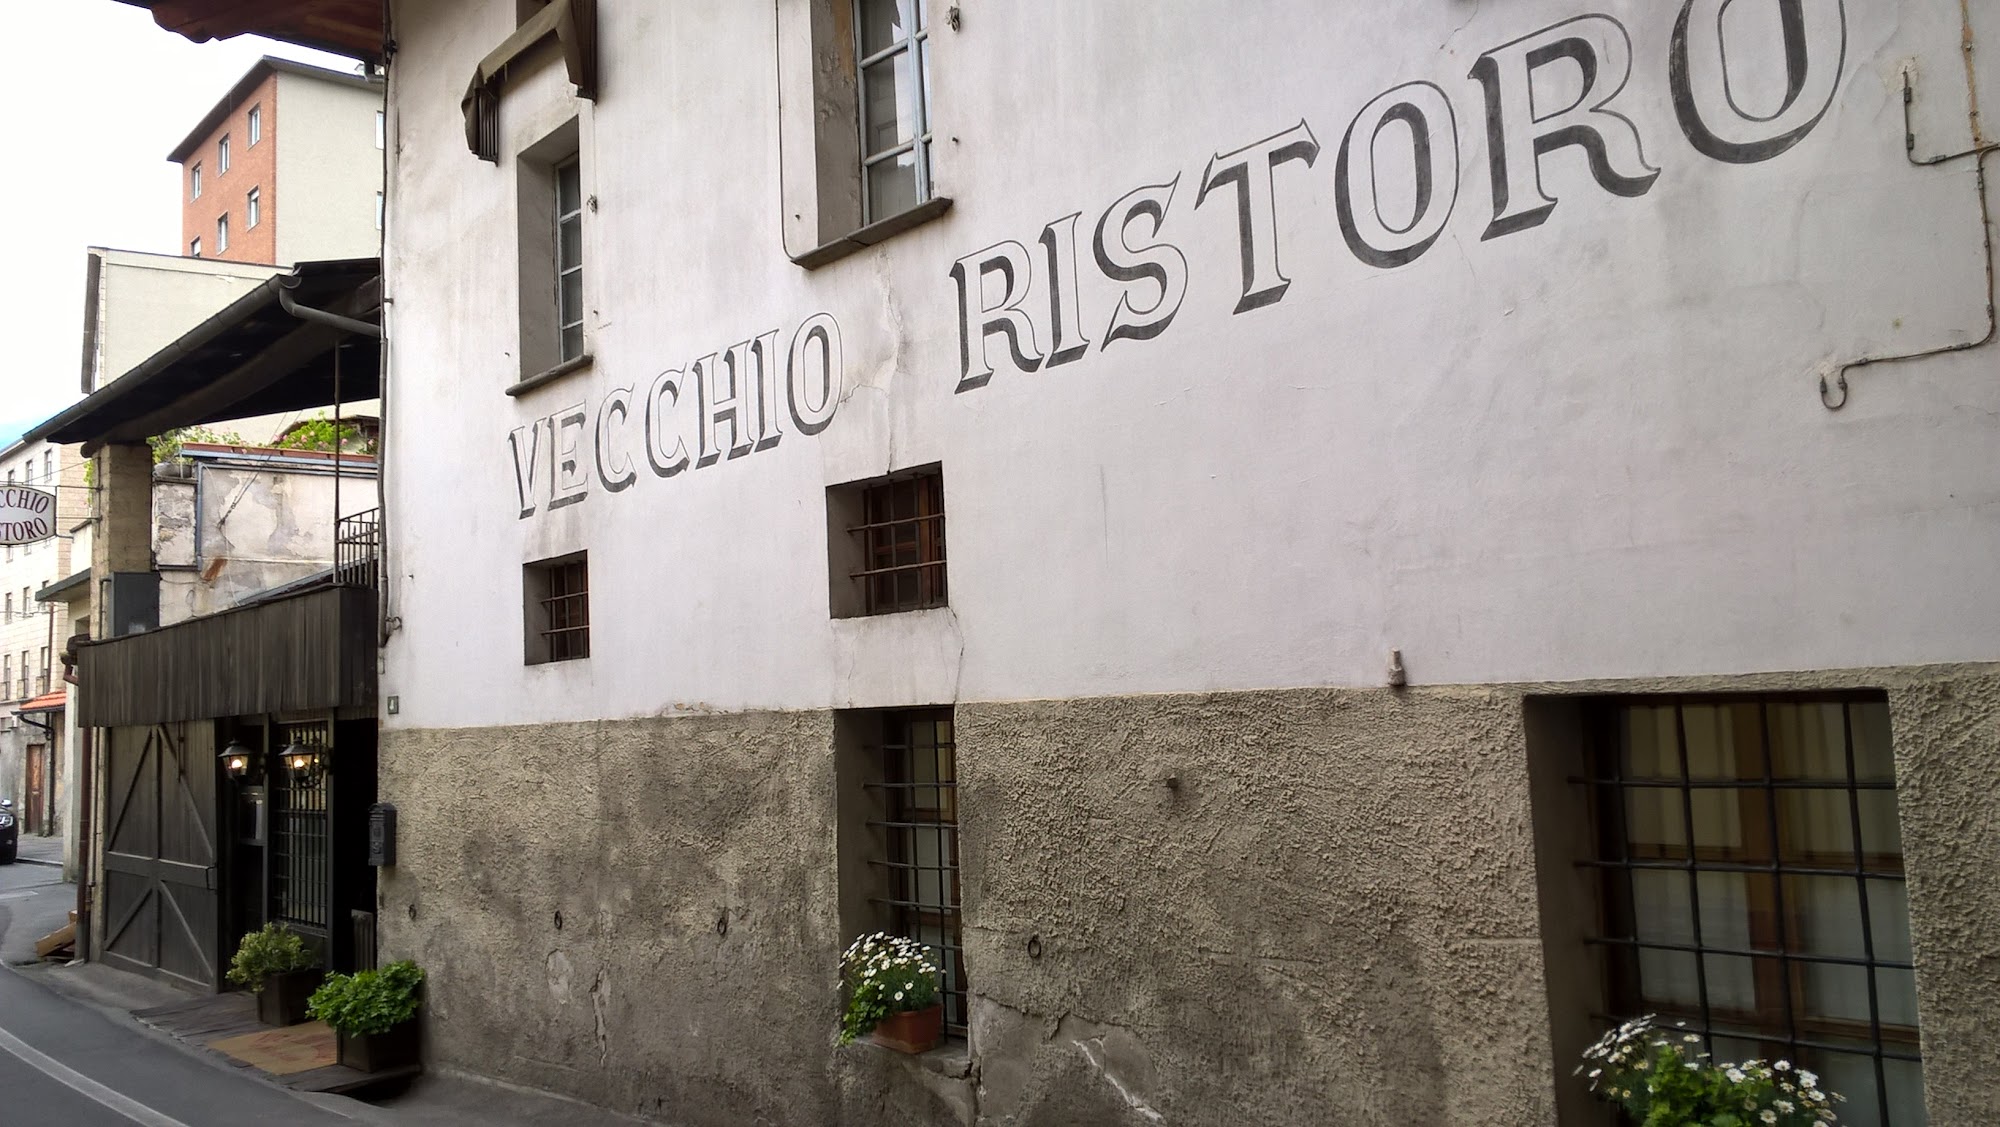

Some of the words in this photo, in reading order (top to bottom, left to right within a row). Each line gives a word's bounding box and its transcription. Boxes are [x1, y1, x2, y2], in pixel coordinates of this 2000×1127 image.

[507, 312, 843, 520] VECCHIO
[949, 0, 1847, 395] RISTORO
[0, 517, 48, 541] TORO
